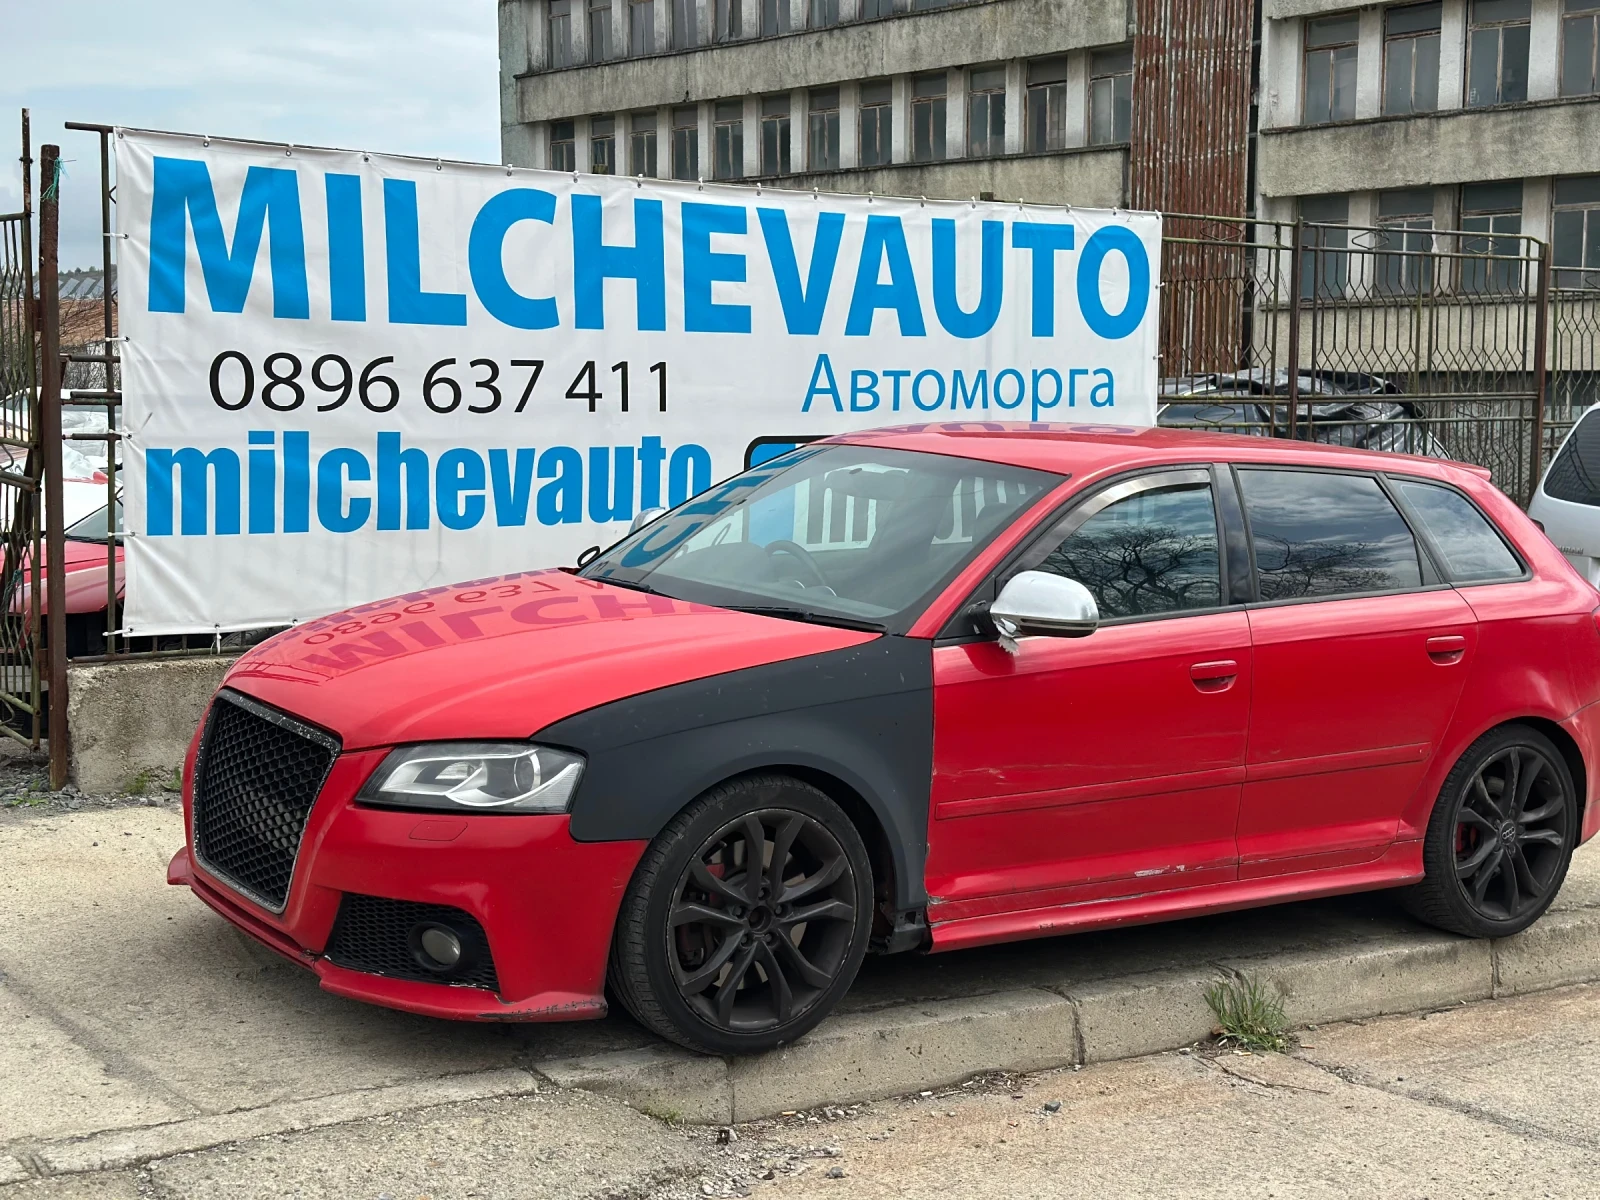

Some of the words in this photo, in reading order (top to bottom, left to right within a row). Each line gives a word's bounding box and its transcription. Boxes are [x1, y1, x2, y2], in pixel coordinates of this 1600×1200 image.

[148, 156, 1150, 340] MILCHEVAUTO
[209, 351, 400, 412] 0896
[422, 357, 544, 413] 637
[566, 361, 668, 412] 411
[801, 353, 1115, 423] Автоморга
[145, 429, 712, 537] milchevauto
